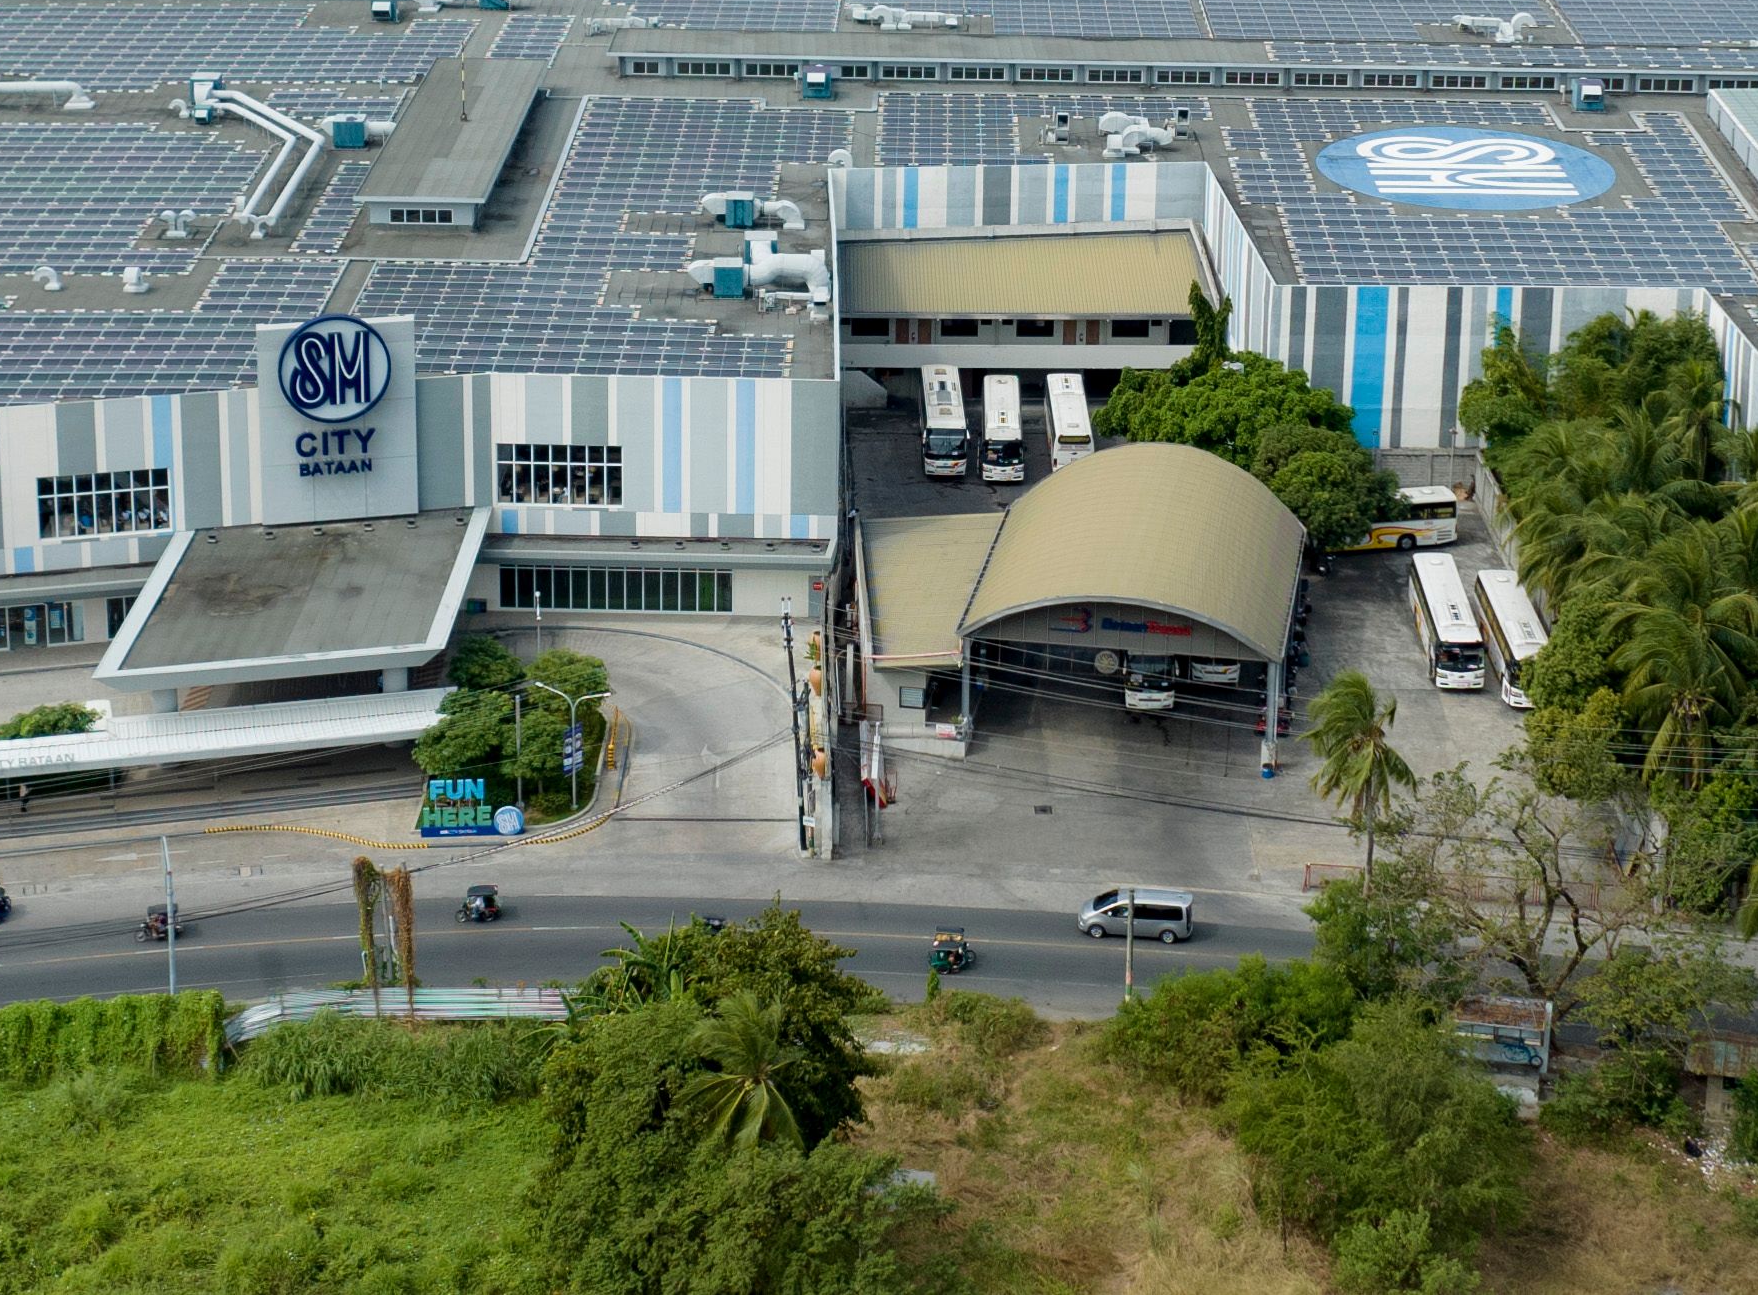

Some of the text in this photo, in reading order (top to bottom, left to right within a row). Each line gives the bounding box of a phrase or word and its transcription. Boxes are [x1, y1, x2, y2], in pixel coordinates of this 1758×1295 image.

[1356, 135, 1580, 196] SM
[290, 331, 371, 409] SM
[295, 428, 376, 457] CITY
[299, 458, 372, 477] BATAAN
[18, 753, 75, 766] BATAAN
[429, 778, 485, 801] FUN
[423, 806, 492, 828] HERE
[496, 811, 520, 834] SM
